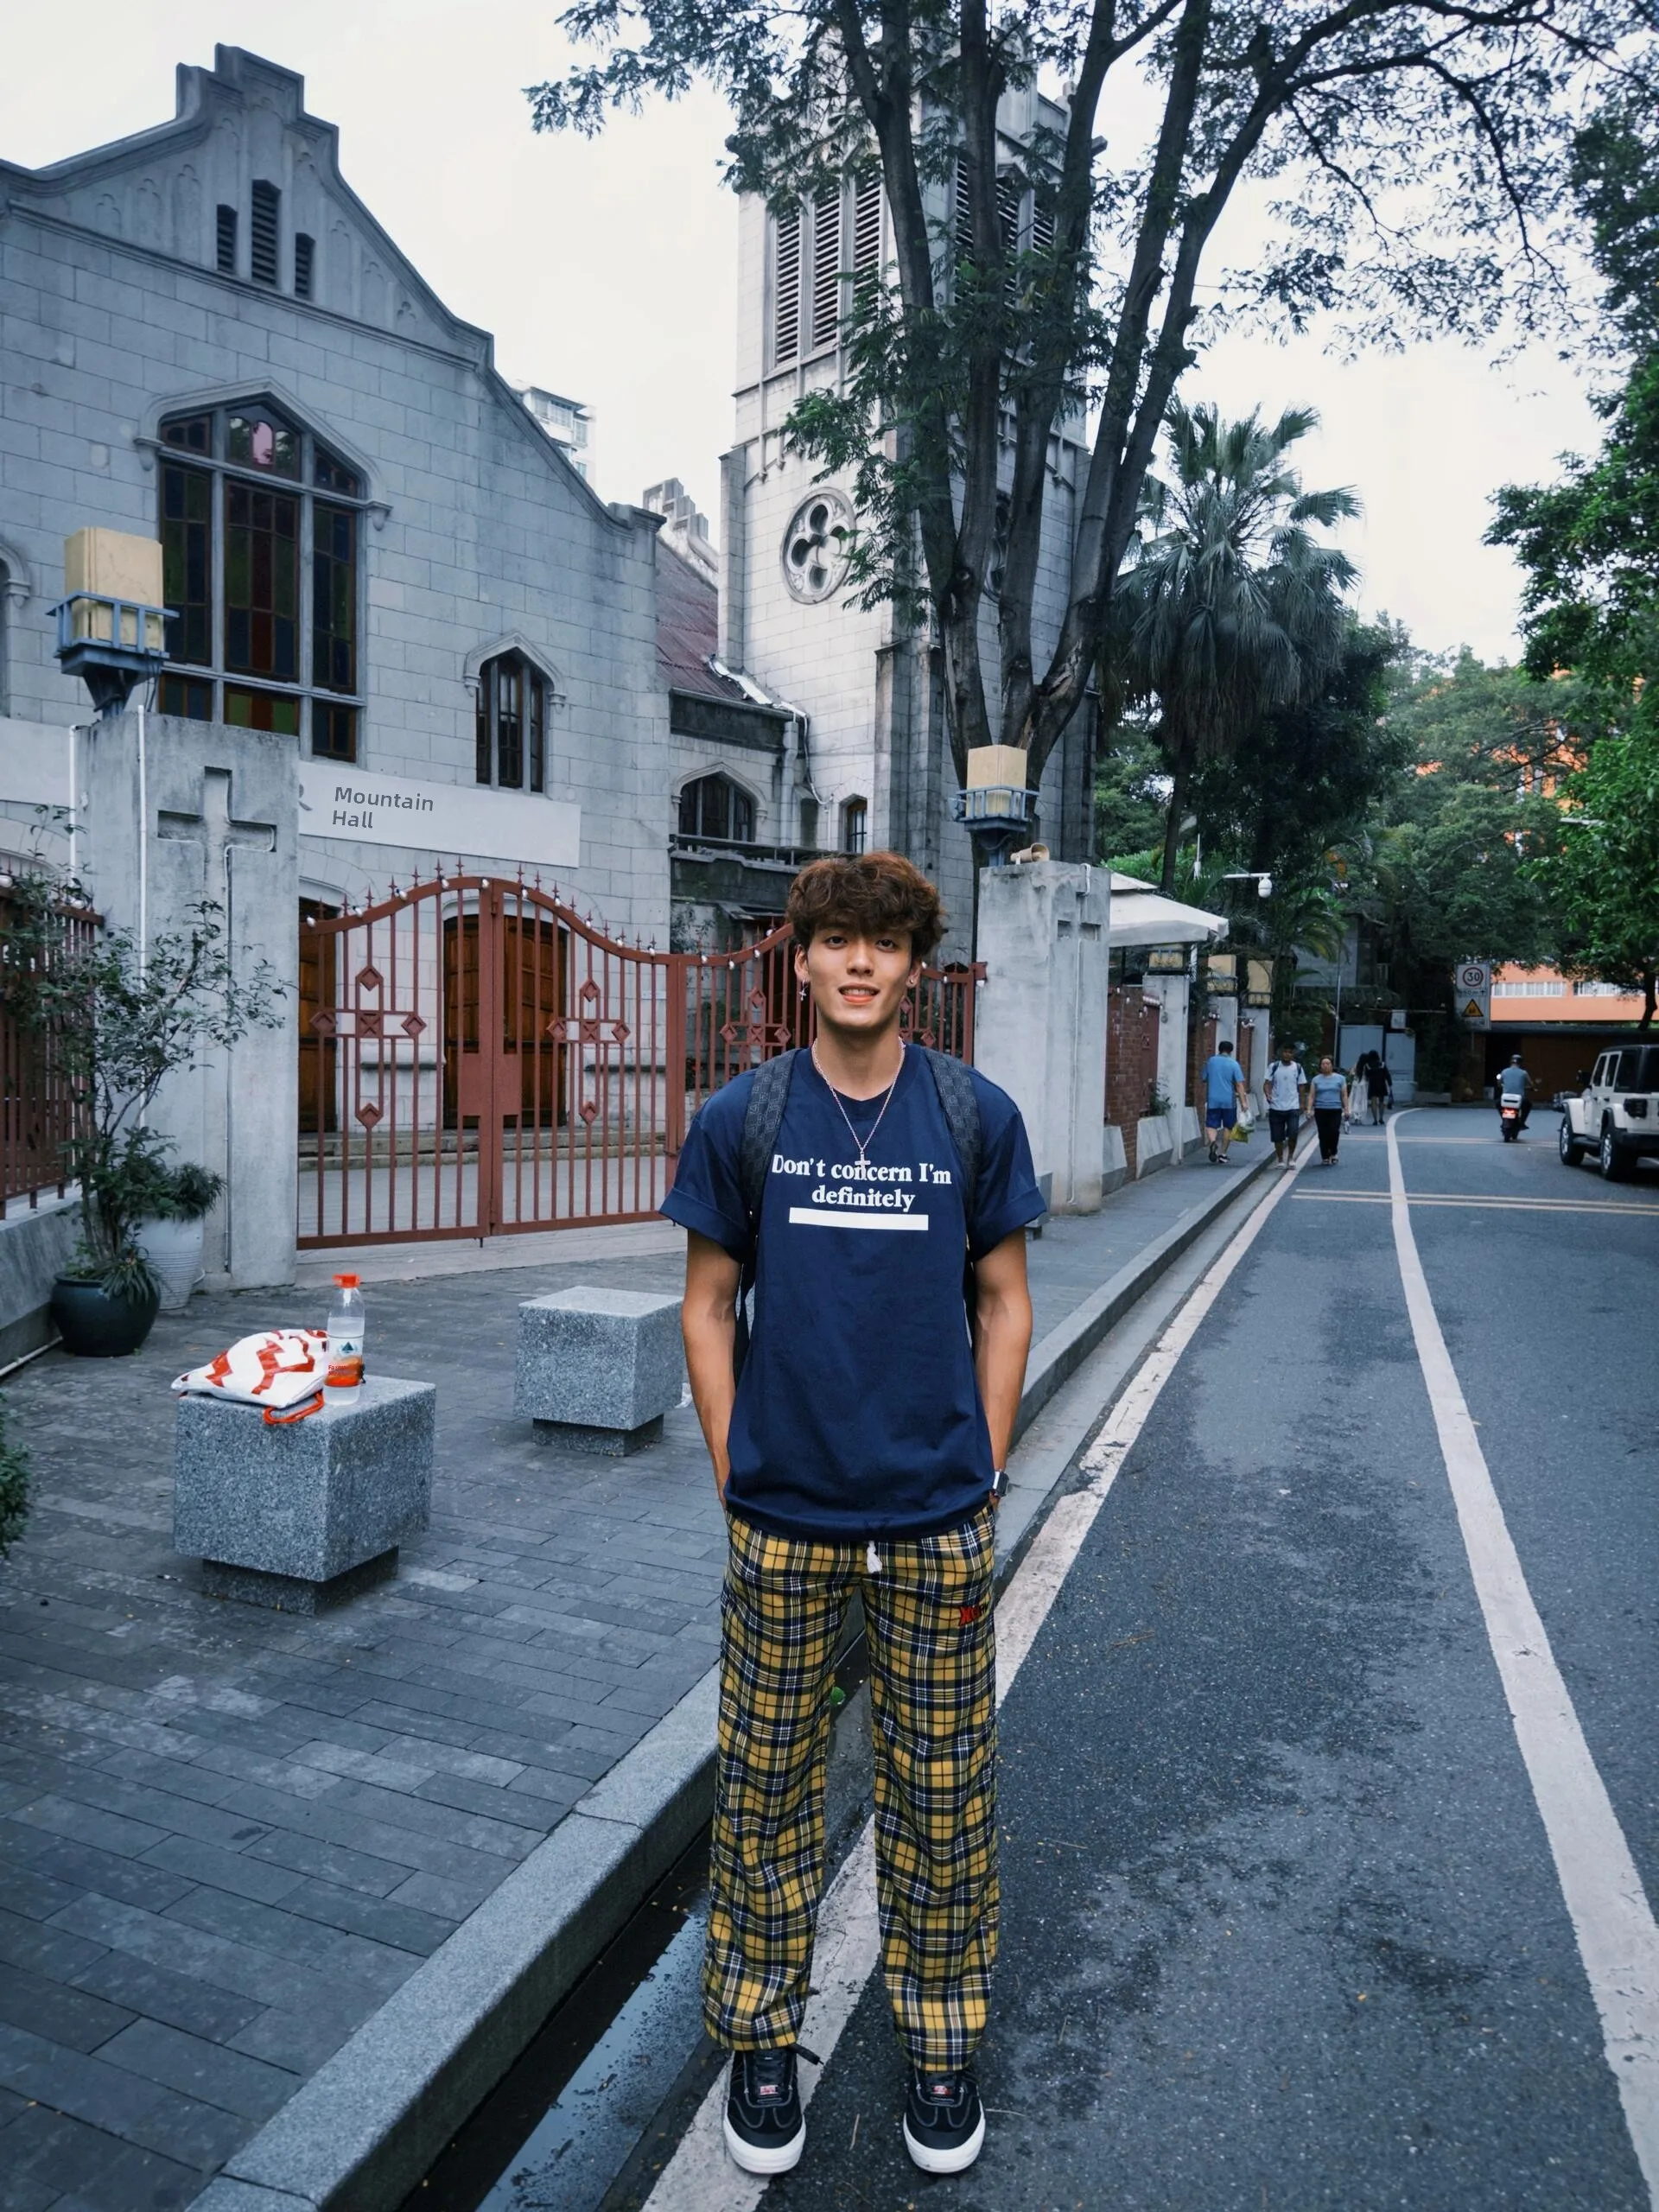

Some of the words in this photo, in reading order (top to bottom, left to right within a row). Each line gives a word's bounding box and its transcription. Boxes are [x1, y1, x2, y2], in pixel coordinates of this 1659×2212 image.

[334, 786, 433, 811] Mountain
[332, 810, 373, 829] Hall
[1467, 972, 1480, 982] 30
[772, 1154, 825, 1177] Don't
[830, 1163, 912, 1182] concern
[919, 1163, 952, 1184] I'm
[811, 1185, 916, 1212] definitely
